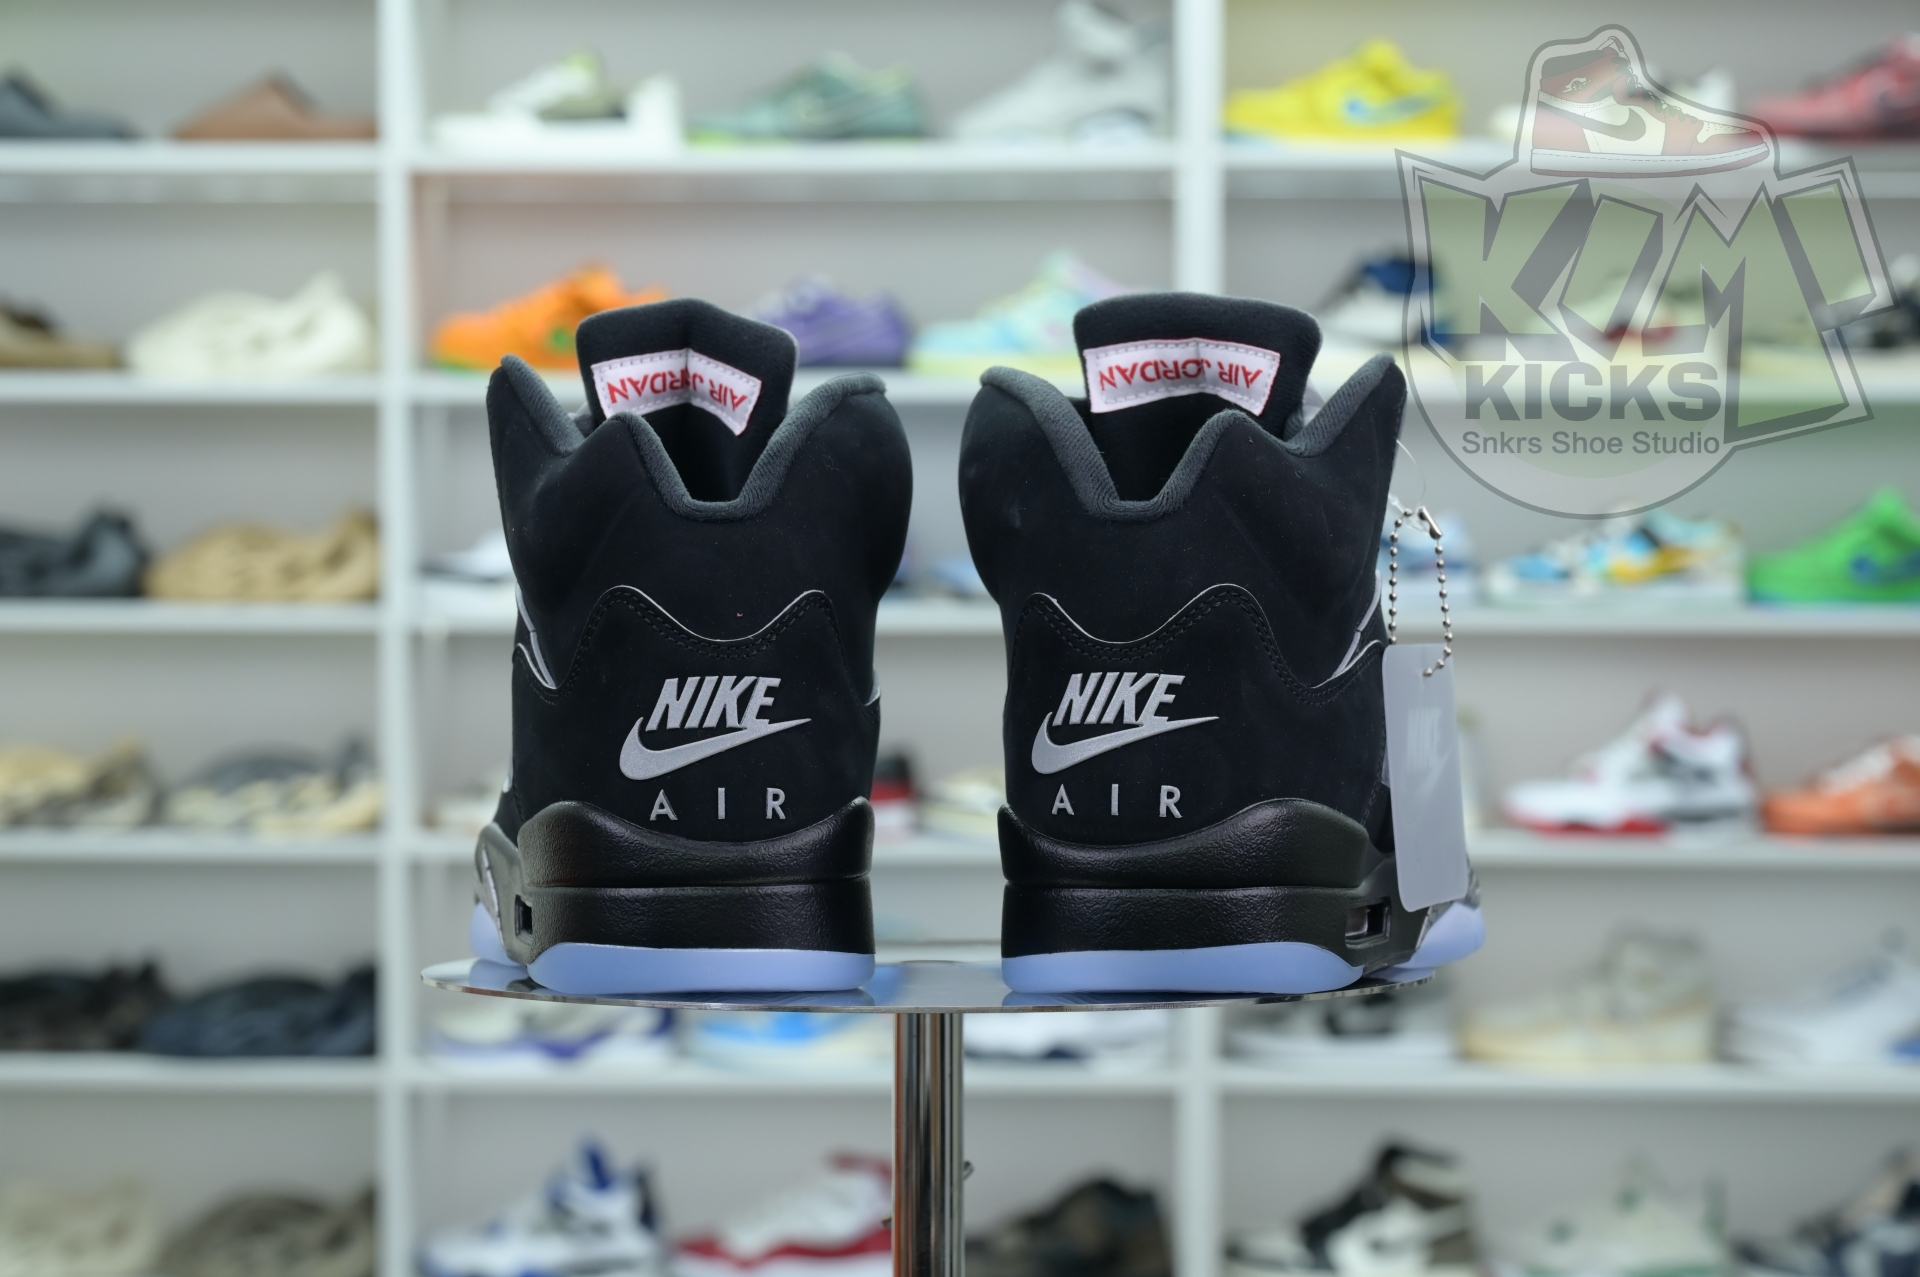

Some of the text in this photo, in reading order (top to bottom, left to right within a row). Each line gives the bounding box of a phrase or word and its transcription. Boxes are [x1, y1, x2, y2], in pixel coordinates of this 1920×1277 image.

[607, 367, 748, 411] AIR JRDAN
[1217, 361, 1263, 389] AIR
[645, 675, 781, 731] NIKE
[1052, 671, 1186, 727] NIKE
